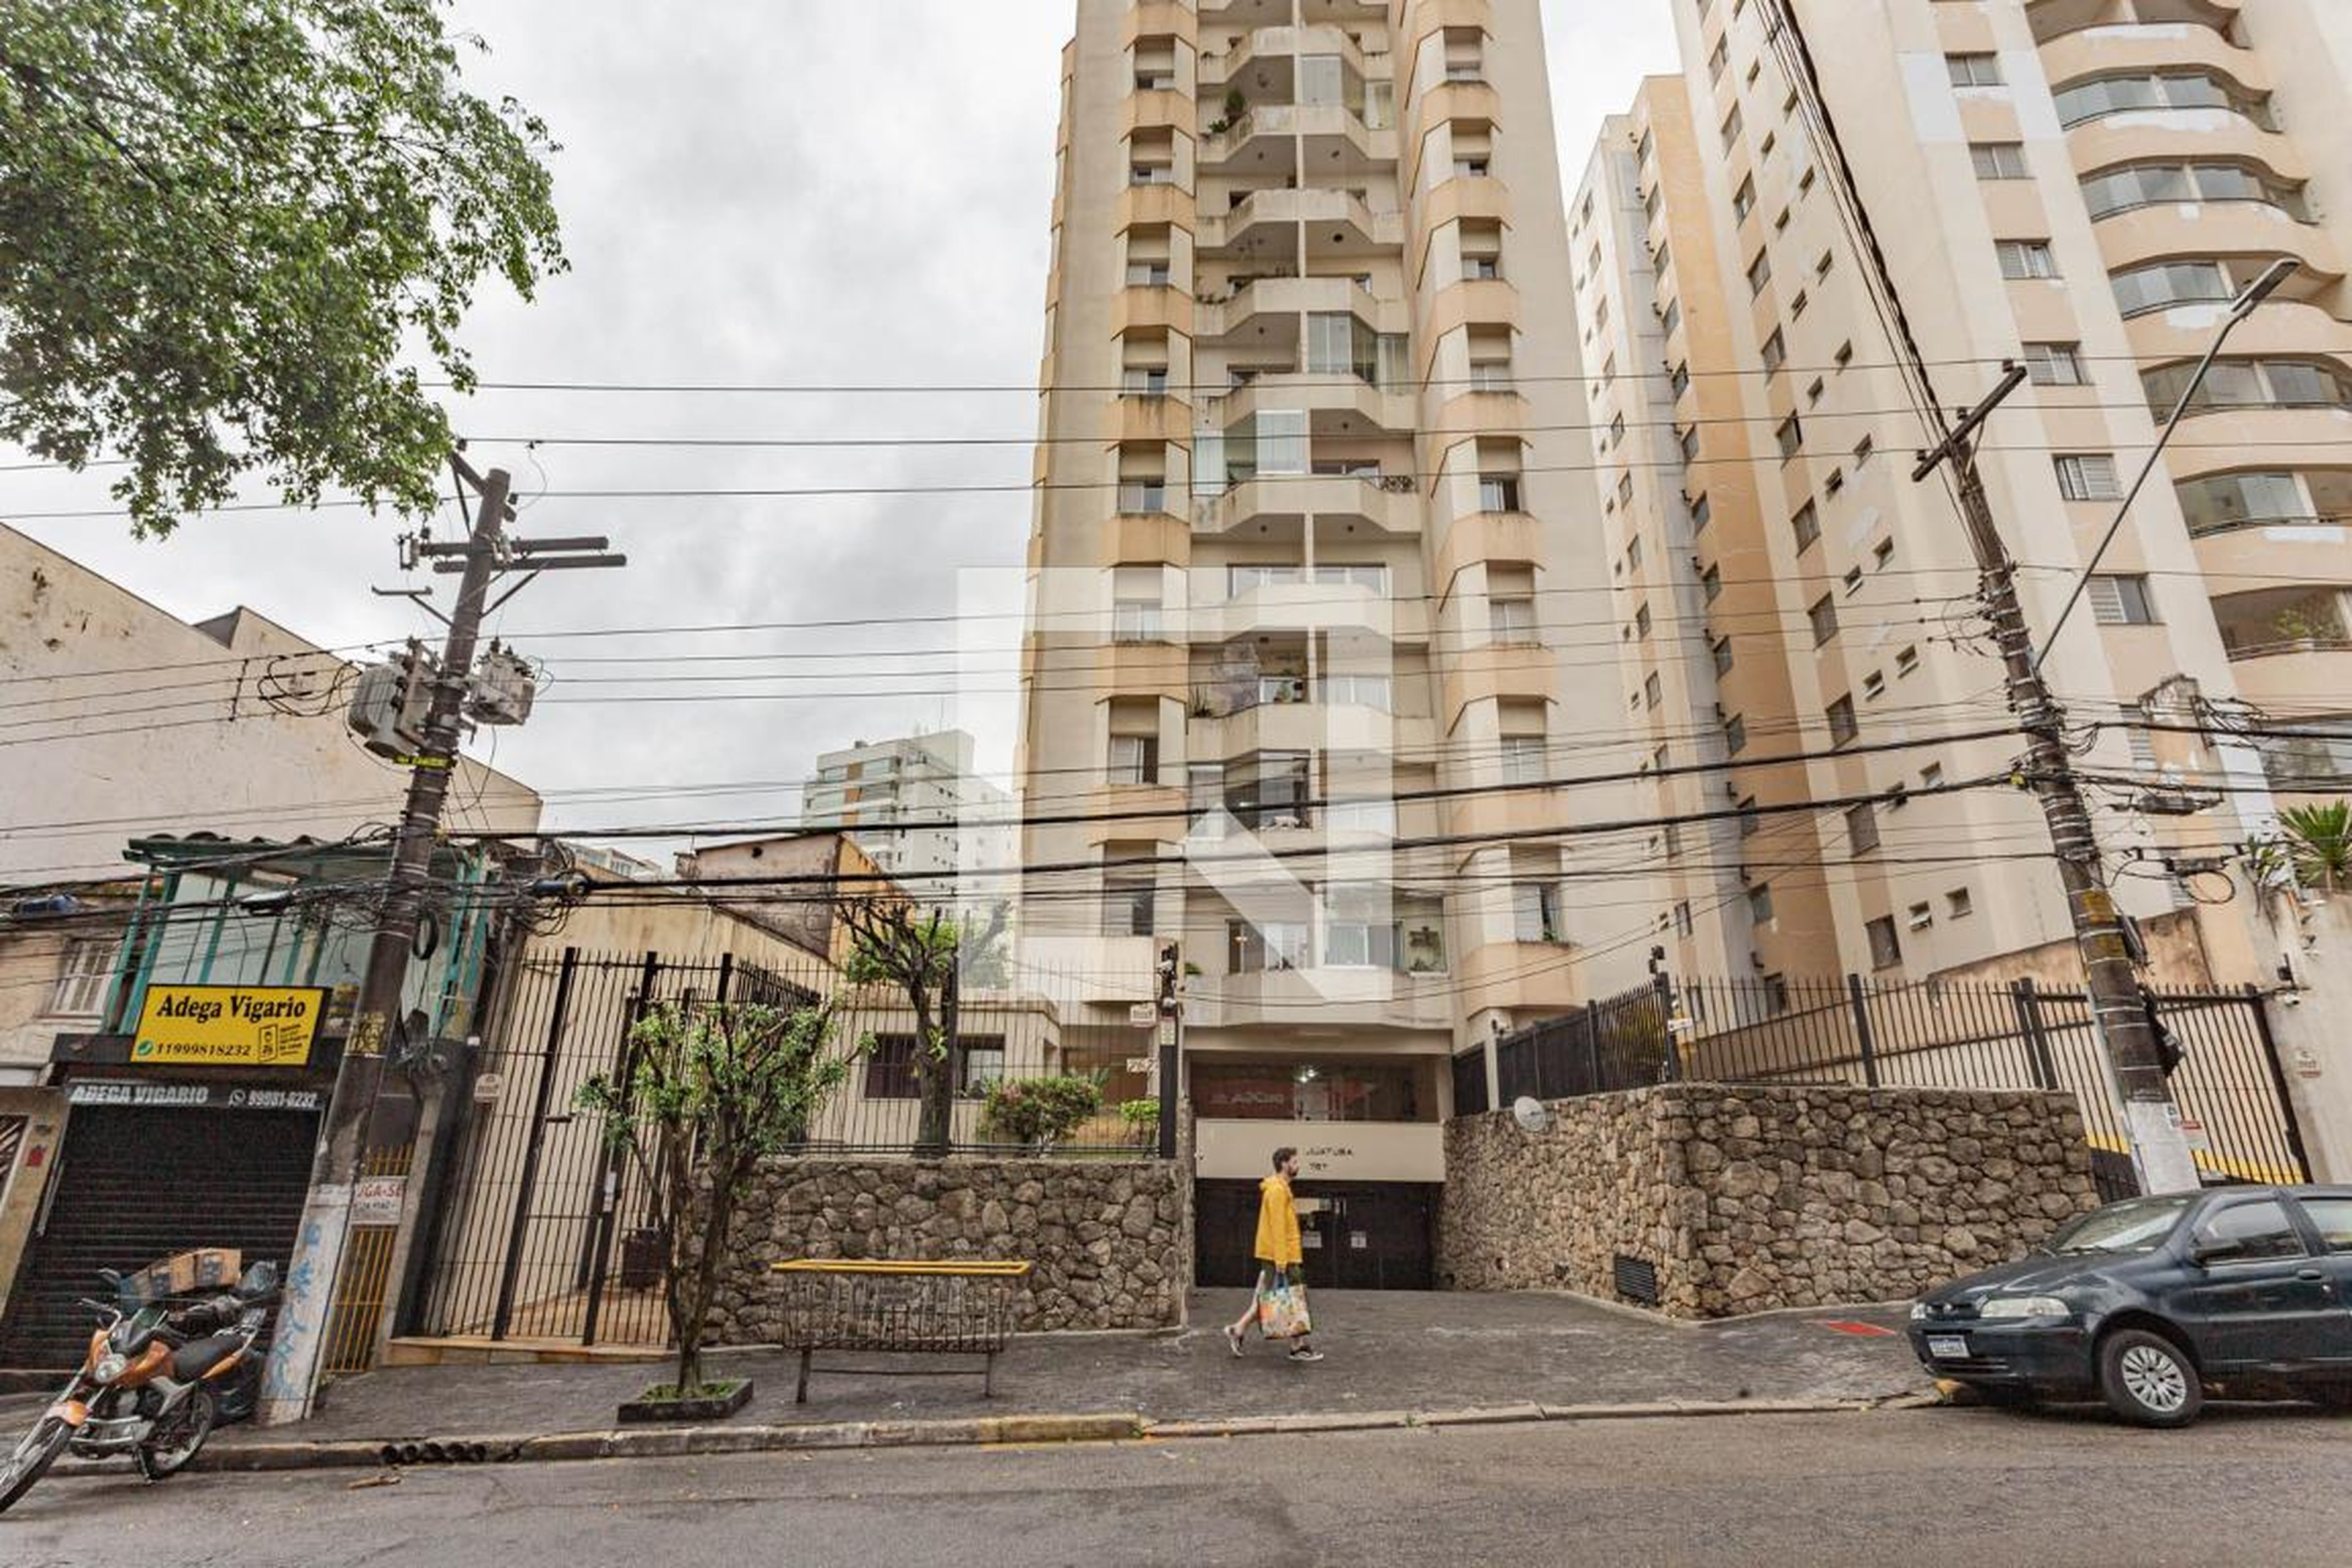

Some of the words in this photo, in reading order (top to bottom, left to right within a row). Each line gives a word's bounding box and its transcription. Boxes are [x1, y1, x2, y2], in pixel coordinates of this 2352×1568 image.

[157, 994, 222, 1023] Adega
[230, 995, 306, 1023] Vigario
[69, 1085, 130, 1102] ADEGA
[134, 1086, 209, 1104] VIGARIO
